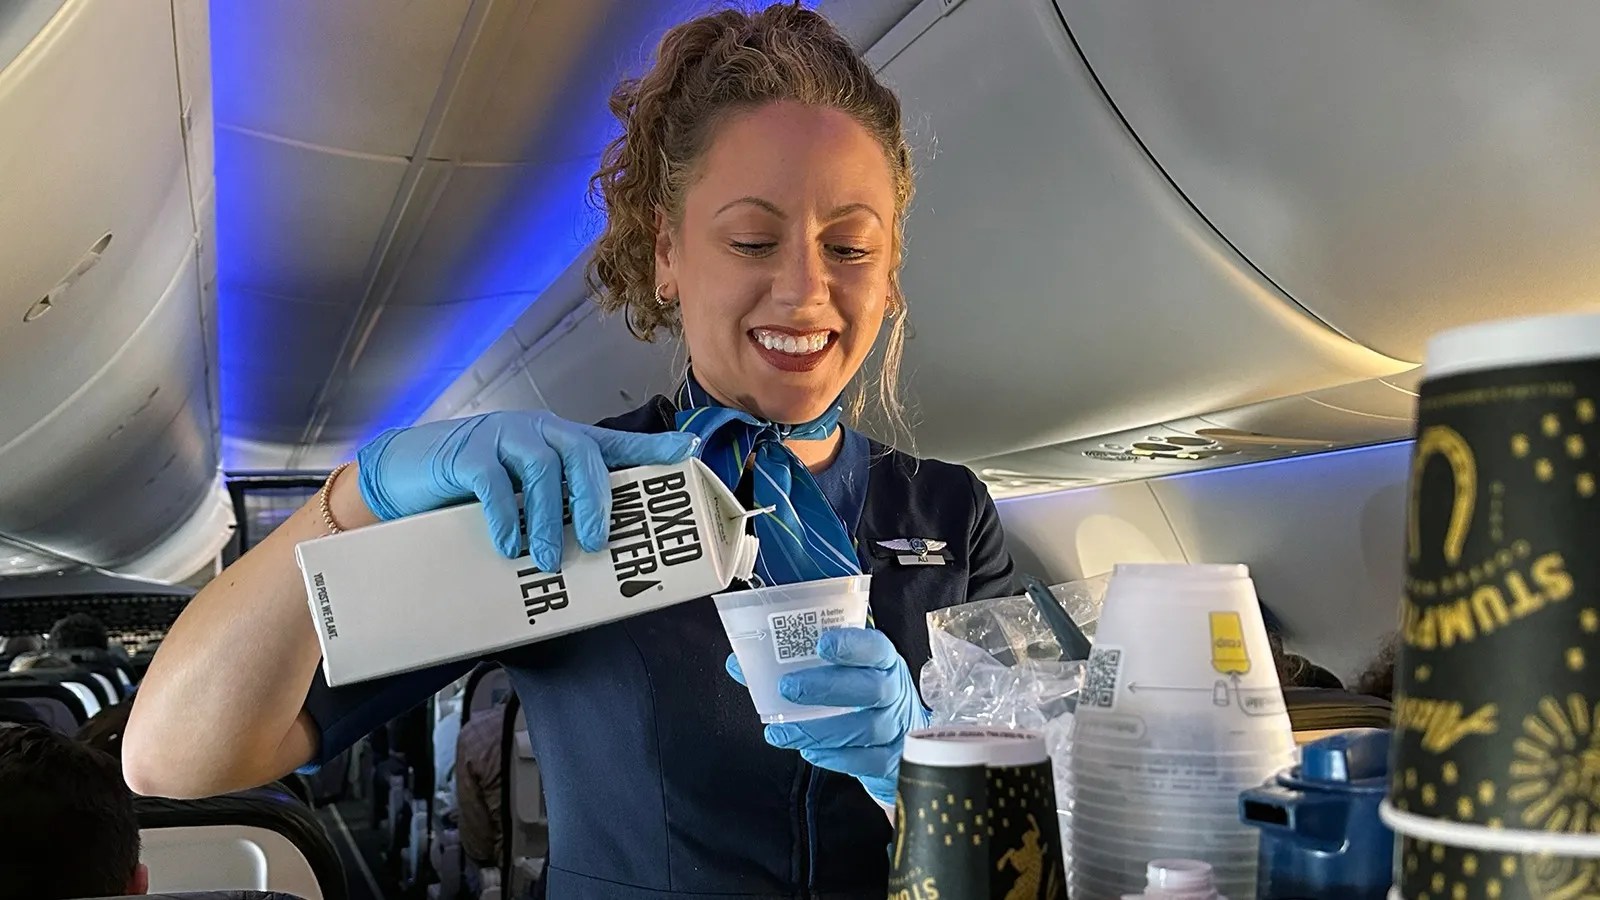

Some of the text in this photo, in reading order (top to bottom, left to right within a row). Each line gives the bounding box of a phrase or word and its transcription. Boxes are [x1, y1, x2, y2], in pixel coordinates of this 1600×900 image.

[608, 481, 658, 581] WATER
[642, 471, 703, 566] BOXED
[314, 572, 338, 641] YOU POST. WE PLANT.
[821, 617, 840, 625] future
[826, 608, 845, 616] better
